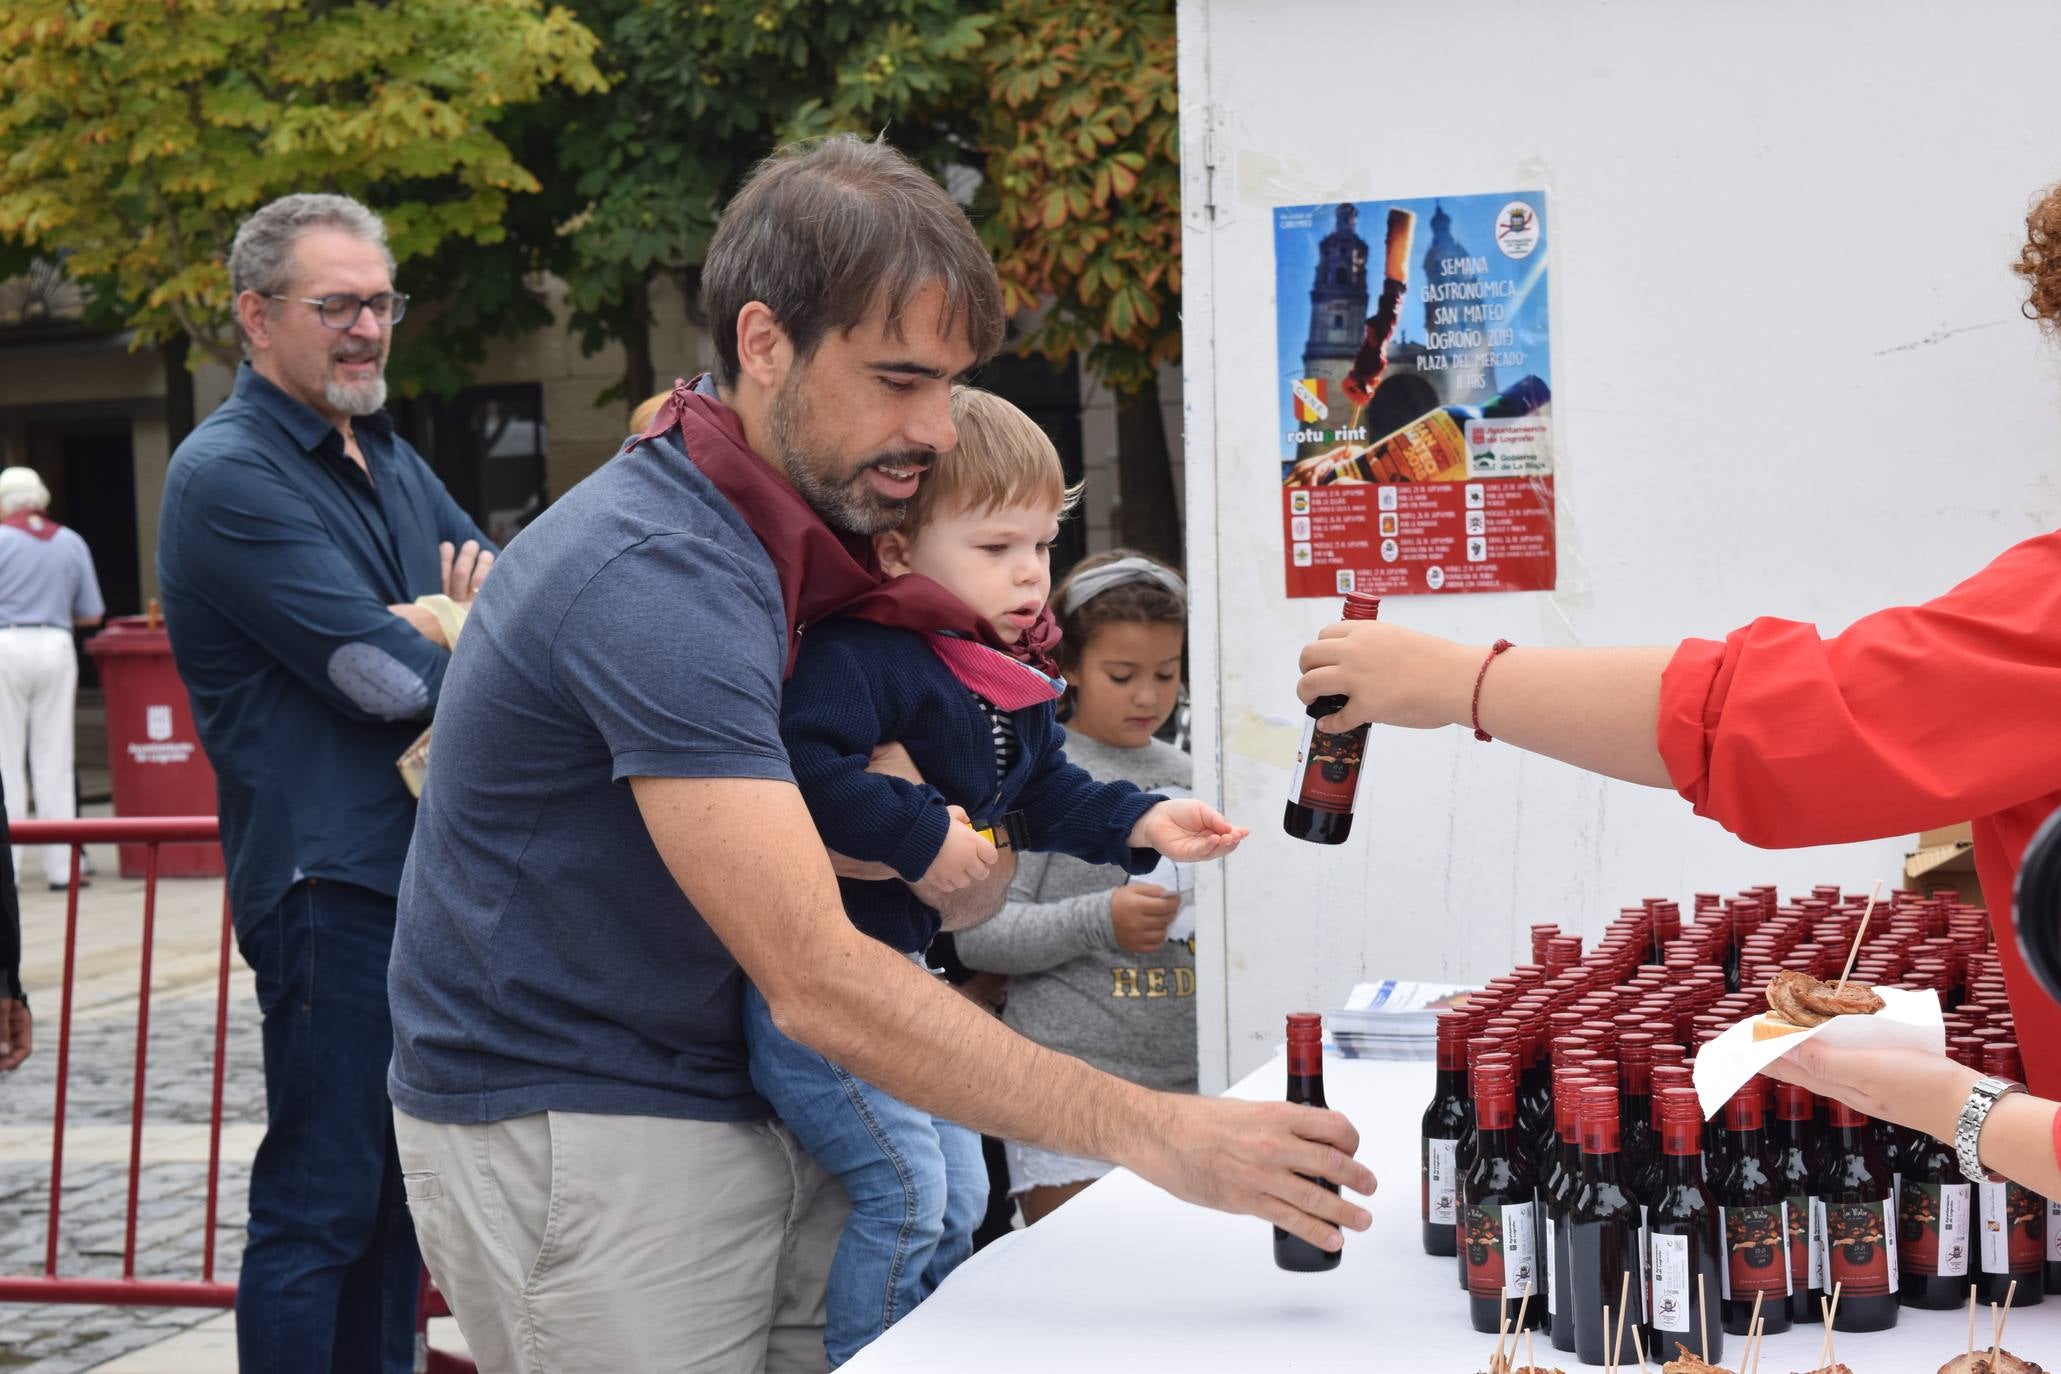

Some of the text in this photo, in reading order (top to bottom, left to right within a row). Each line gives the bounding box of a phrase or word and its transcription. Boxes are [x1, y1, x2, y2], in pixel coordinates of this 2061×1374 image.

[1440, 256, 1488, 277] SEMANA
[1433, 303, 1504, 325] SAN MATEO
[1426, 327, 1514, 350] LOGROÑO 2019
[1416, 350, 1524, 371] PLAZA DEL MERCADO
[1286, 425, 1368, 447] rotuprint
[1487, 424, 1547, 437] Ayuntamiento
[1500, 433, 1535, 444] Logroño
